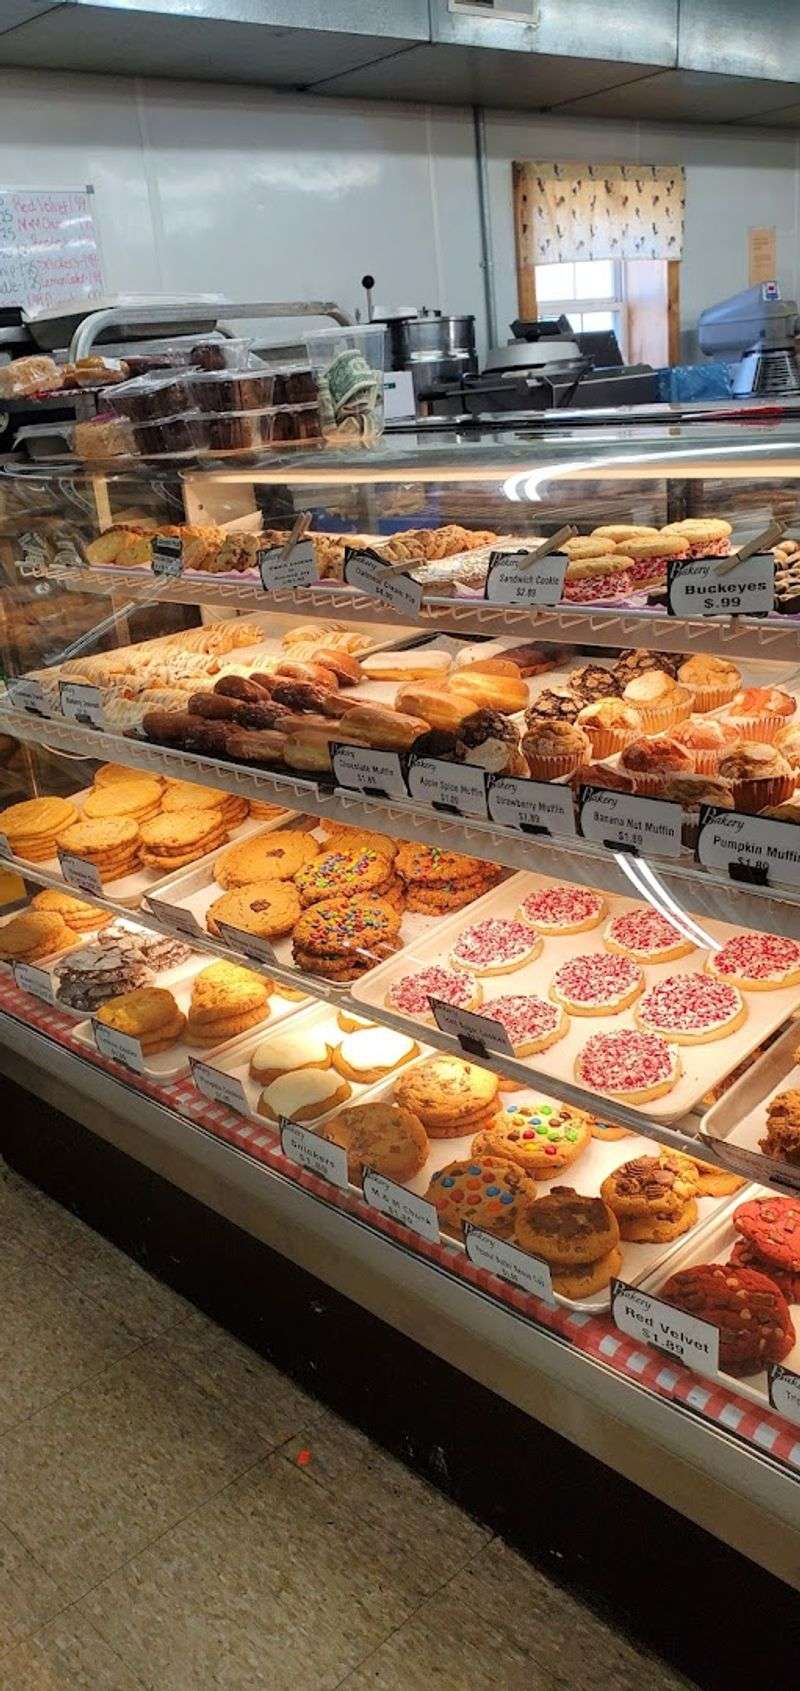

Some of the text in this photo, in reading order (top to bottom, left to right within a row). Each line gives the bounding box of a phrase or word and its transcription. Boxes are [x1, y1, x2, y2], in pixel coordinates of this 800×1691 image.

[499, 573, 560, 586] Sandwich Cookie
[671, 562, 711, 579] Bakery
[684, 582, 767, 595] Buckeyes
[704, 597, 741, 609] $.99
[420, 777, 438, 788] Apple
[460, 785, 483, 797] Muffin
[487, 775, 518, 794] Bakery
[496, 796, 565, 814] Strawberry Muffin
[582, 786, 618, 809] Bakery
[593, 811, 675, 837] Banana Nut Muffin
[702, 807, 744, 833] Bakery
[713, 834, 762, 855] Pumpkin
[291, 1140, 335, 1168] Snickers
[613, 1281, 652, 1312] Bakery
[625, 1305, 709, 1354] Red Velvet
